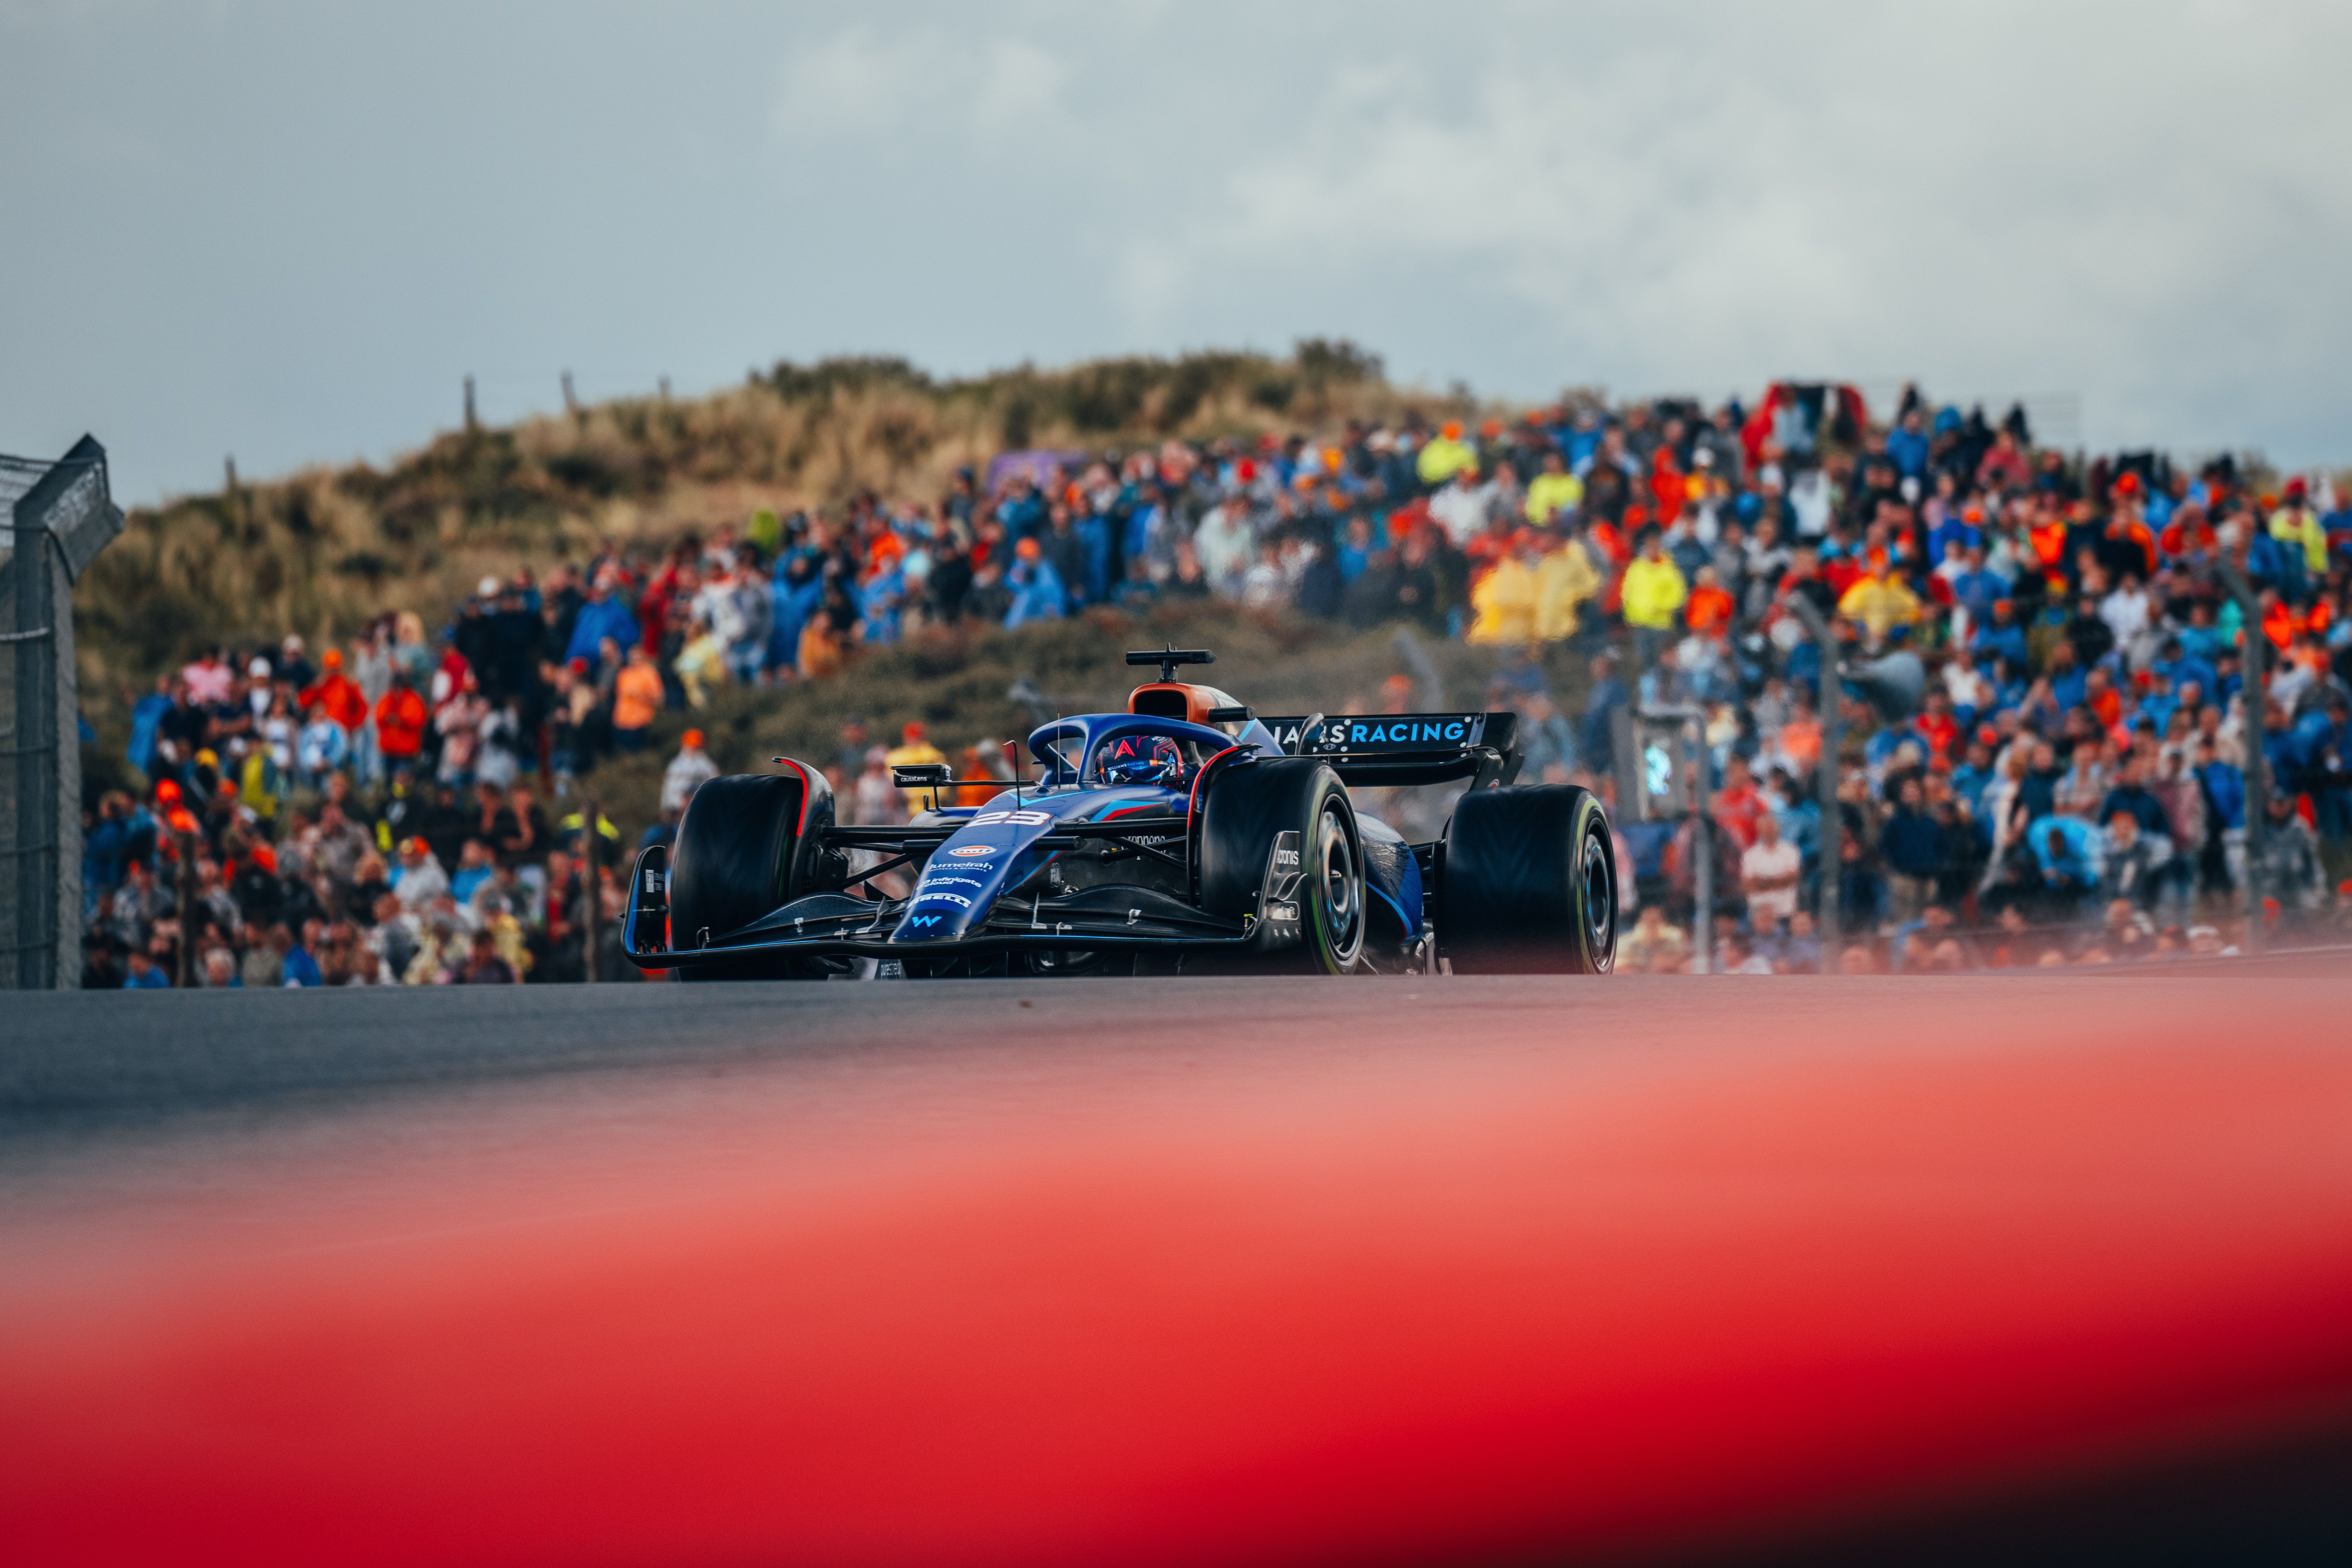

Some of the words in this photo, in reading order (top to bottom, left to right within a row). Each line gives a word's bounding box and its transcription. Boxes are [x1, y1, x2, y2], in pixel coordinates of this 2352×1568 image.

[1351, 722, 1464, 742] RACING
[965, 811, 1052, 828] 23
[932, 877, 982, 887] infinigate
